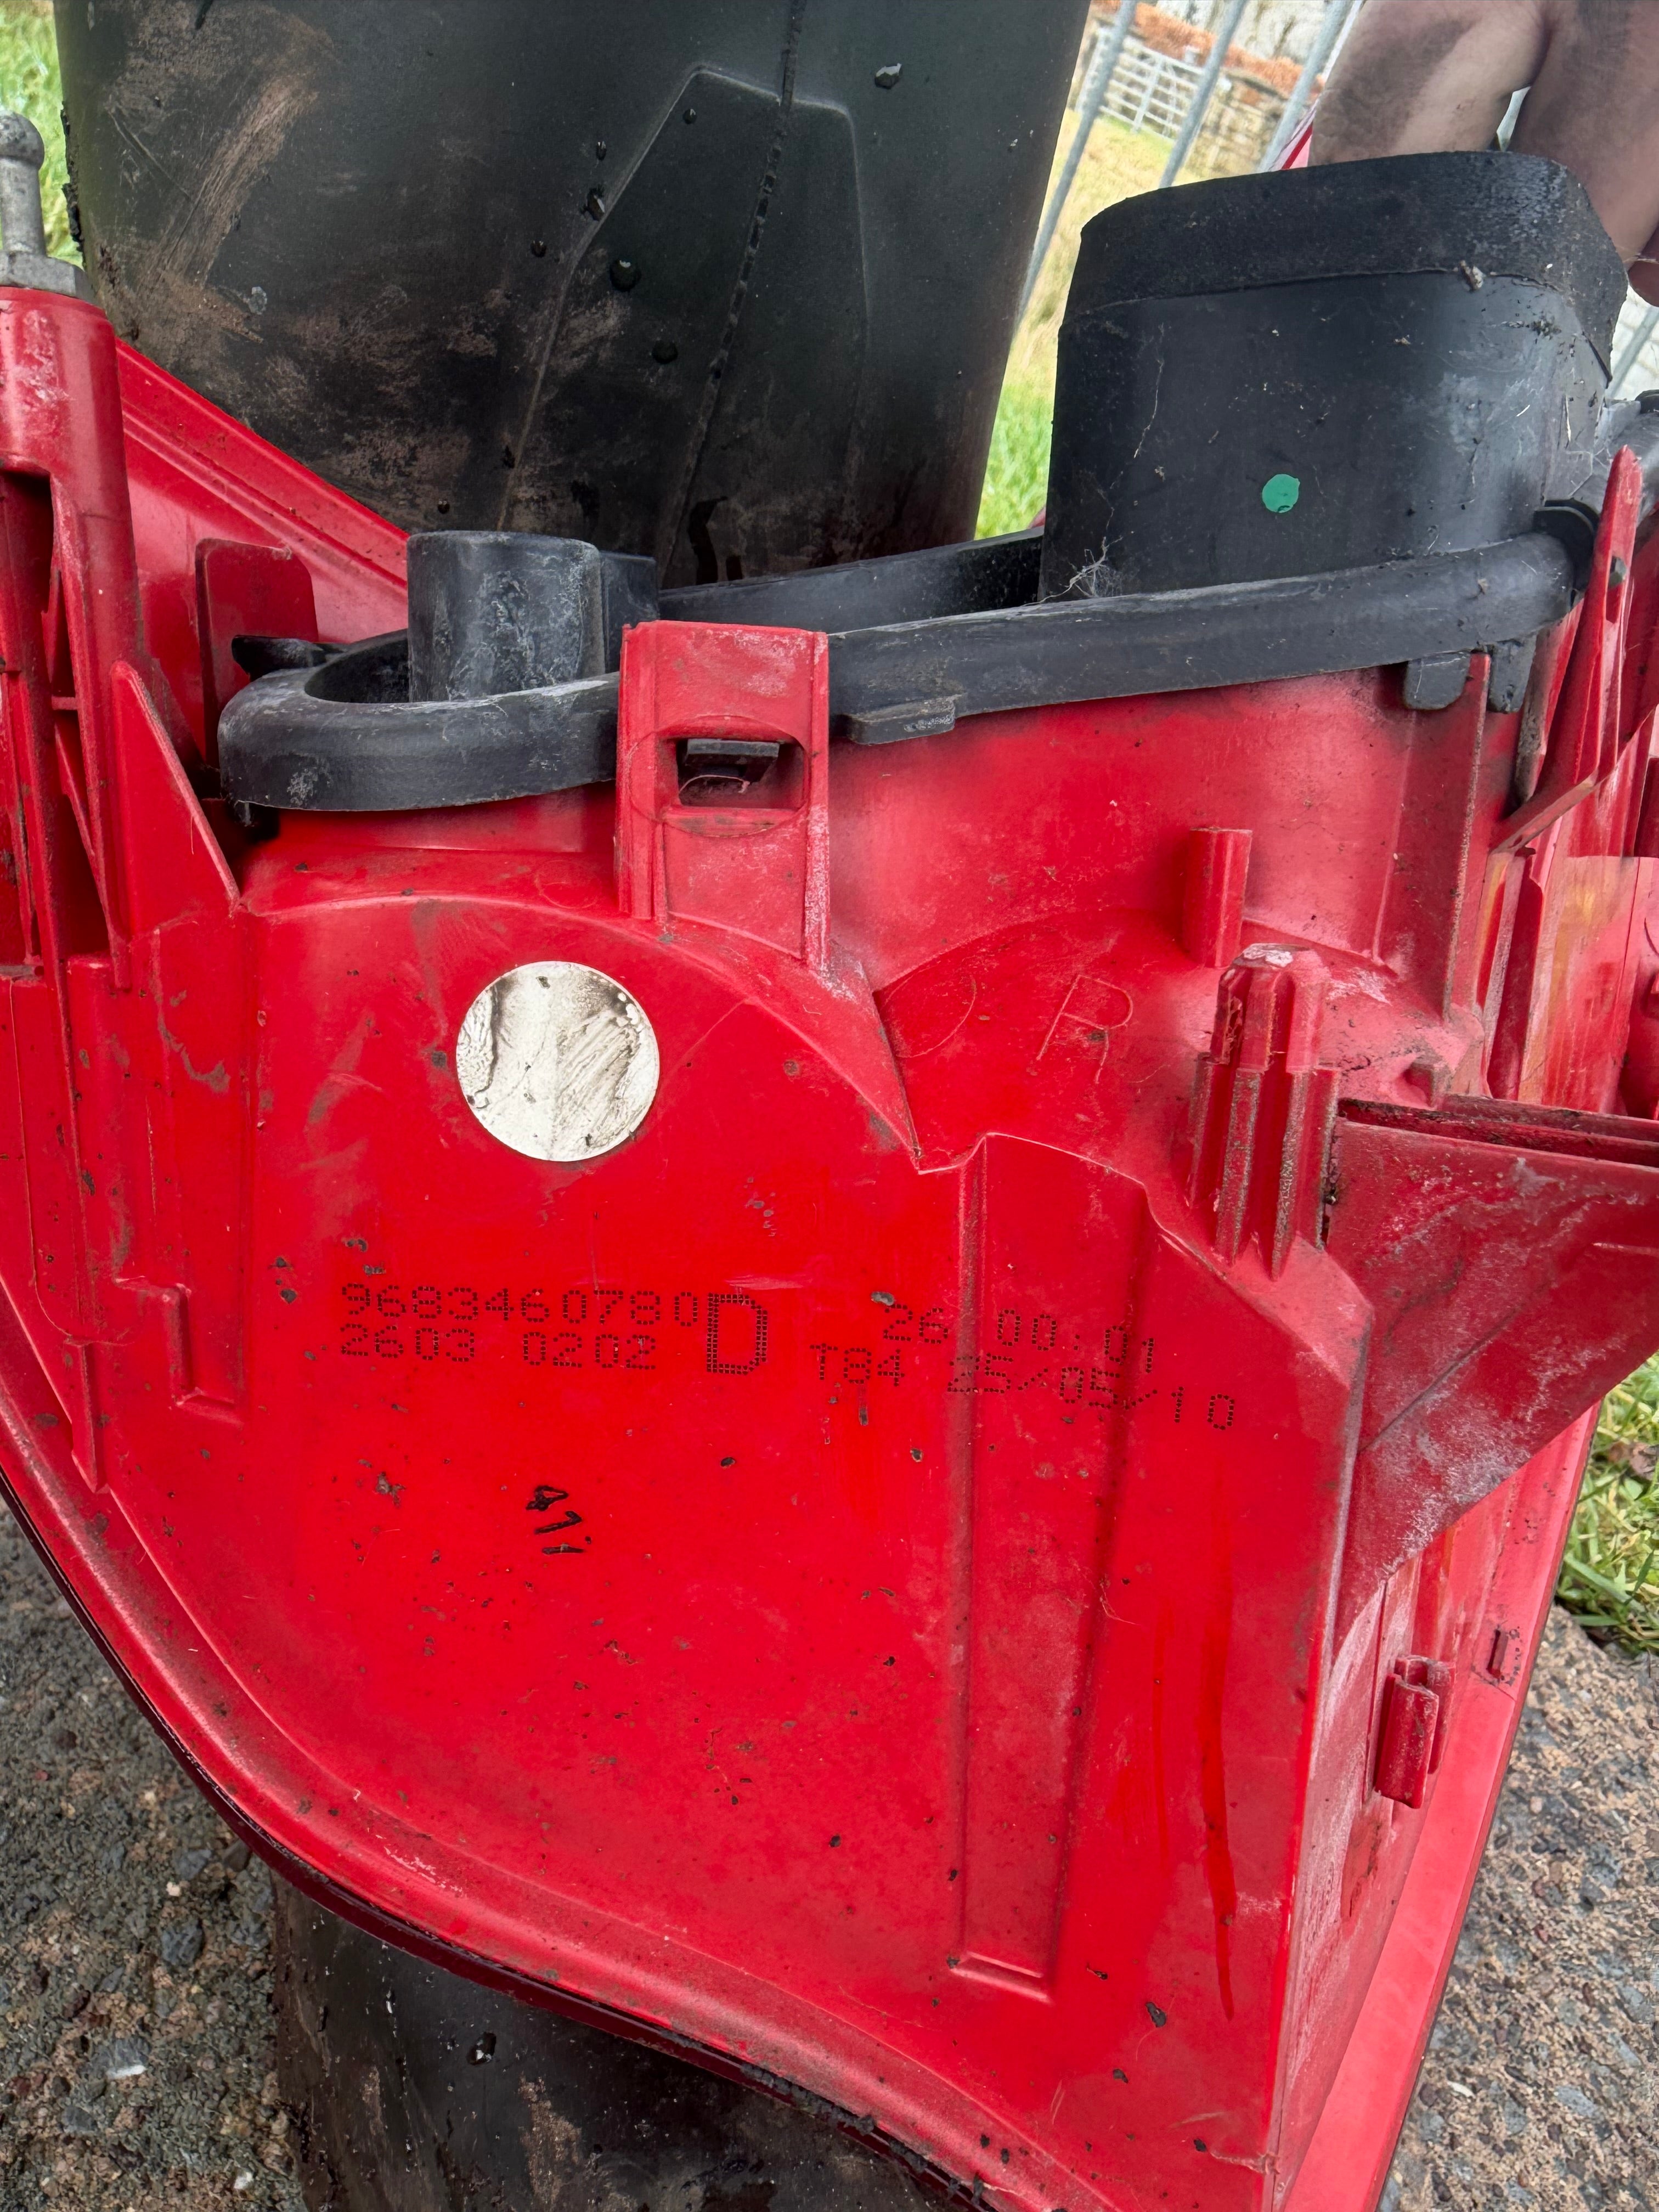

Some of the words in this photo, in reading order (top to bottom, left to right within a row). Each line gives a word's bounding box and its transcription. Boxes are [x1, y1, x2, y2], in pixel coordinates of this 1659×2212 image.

[339, 1323, 476, 1362] 2603
[522, 1331, 657, 1369] 0202
[341, 1282, 699, 1327] 9683460780
[706, 1293, 768, 1375] D
[882, 1303, 949, 1345] 26
[809, 1342, 905, 1387] T84
